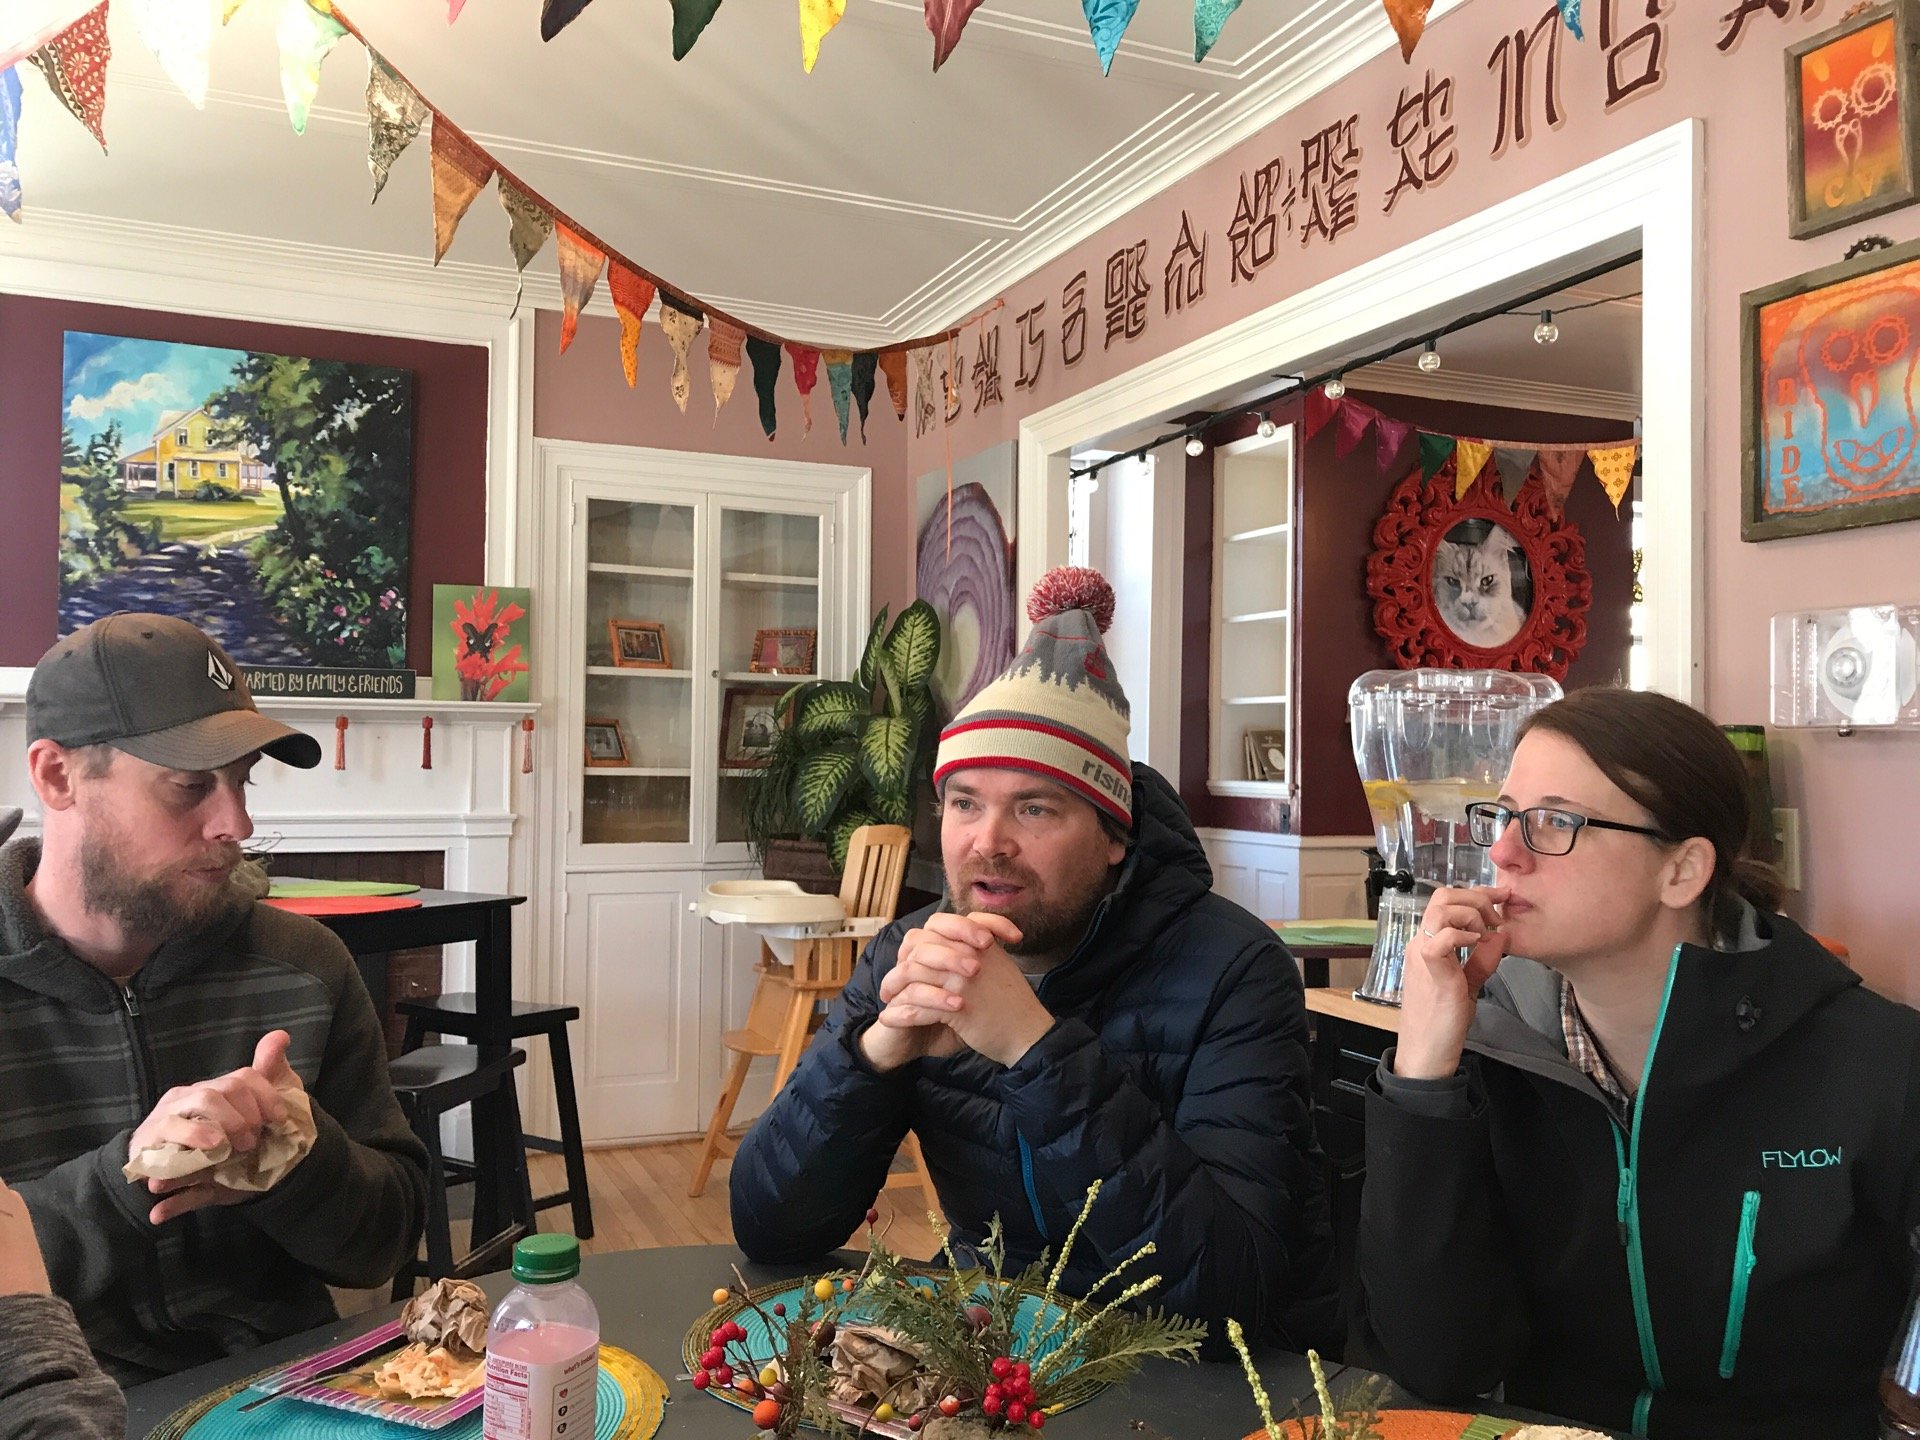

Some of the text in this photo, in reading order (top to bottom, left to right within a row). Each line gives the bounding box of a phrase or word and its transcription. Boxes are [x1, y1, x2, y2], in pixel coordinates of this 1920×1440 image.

[1014, 299, 1046, 388] IS
[1777, 377, 1805, 506] RIDE
[243, 671, 286, 692] ARMED
[288, 673, 303, 692] BY
[306, 673, 346, 693] FAMILY
[358, 674, 404, 694] FRIENDS
[1761, 1146, 1842, 1169] FLYLOW
